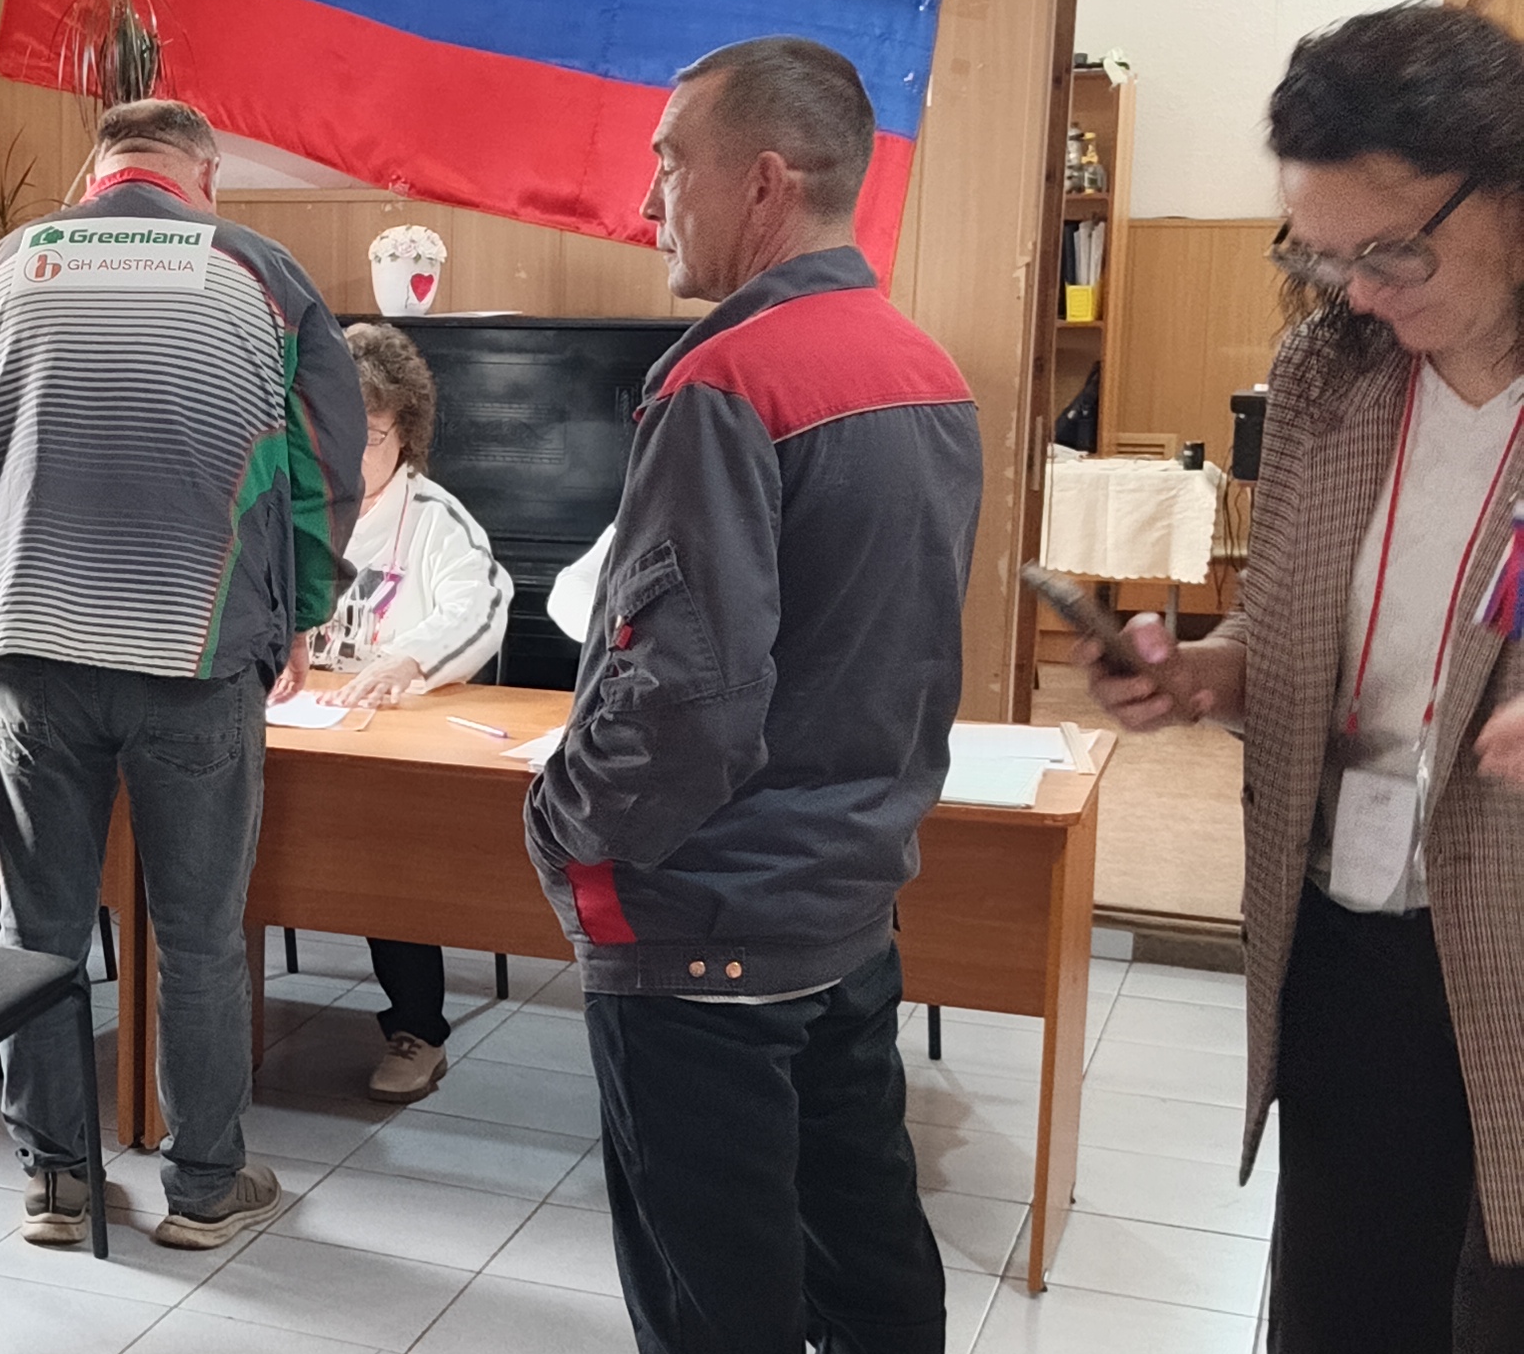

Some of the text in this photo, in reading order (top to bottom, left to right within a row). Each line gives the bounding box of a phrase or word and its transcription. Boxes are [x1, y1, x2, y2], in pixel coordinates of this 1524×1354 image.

[68, 228, 202, 246] Greenland
[67, 258, 195, 273] GH AUSTRALIA
